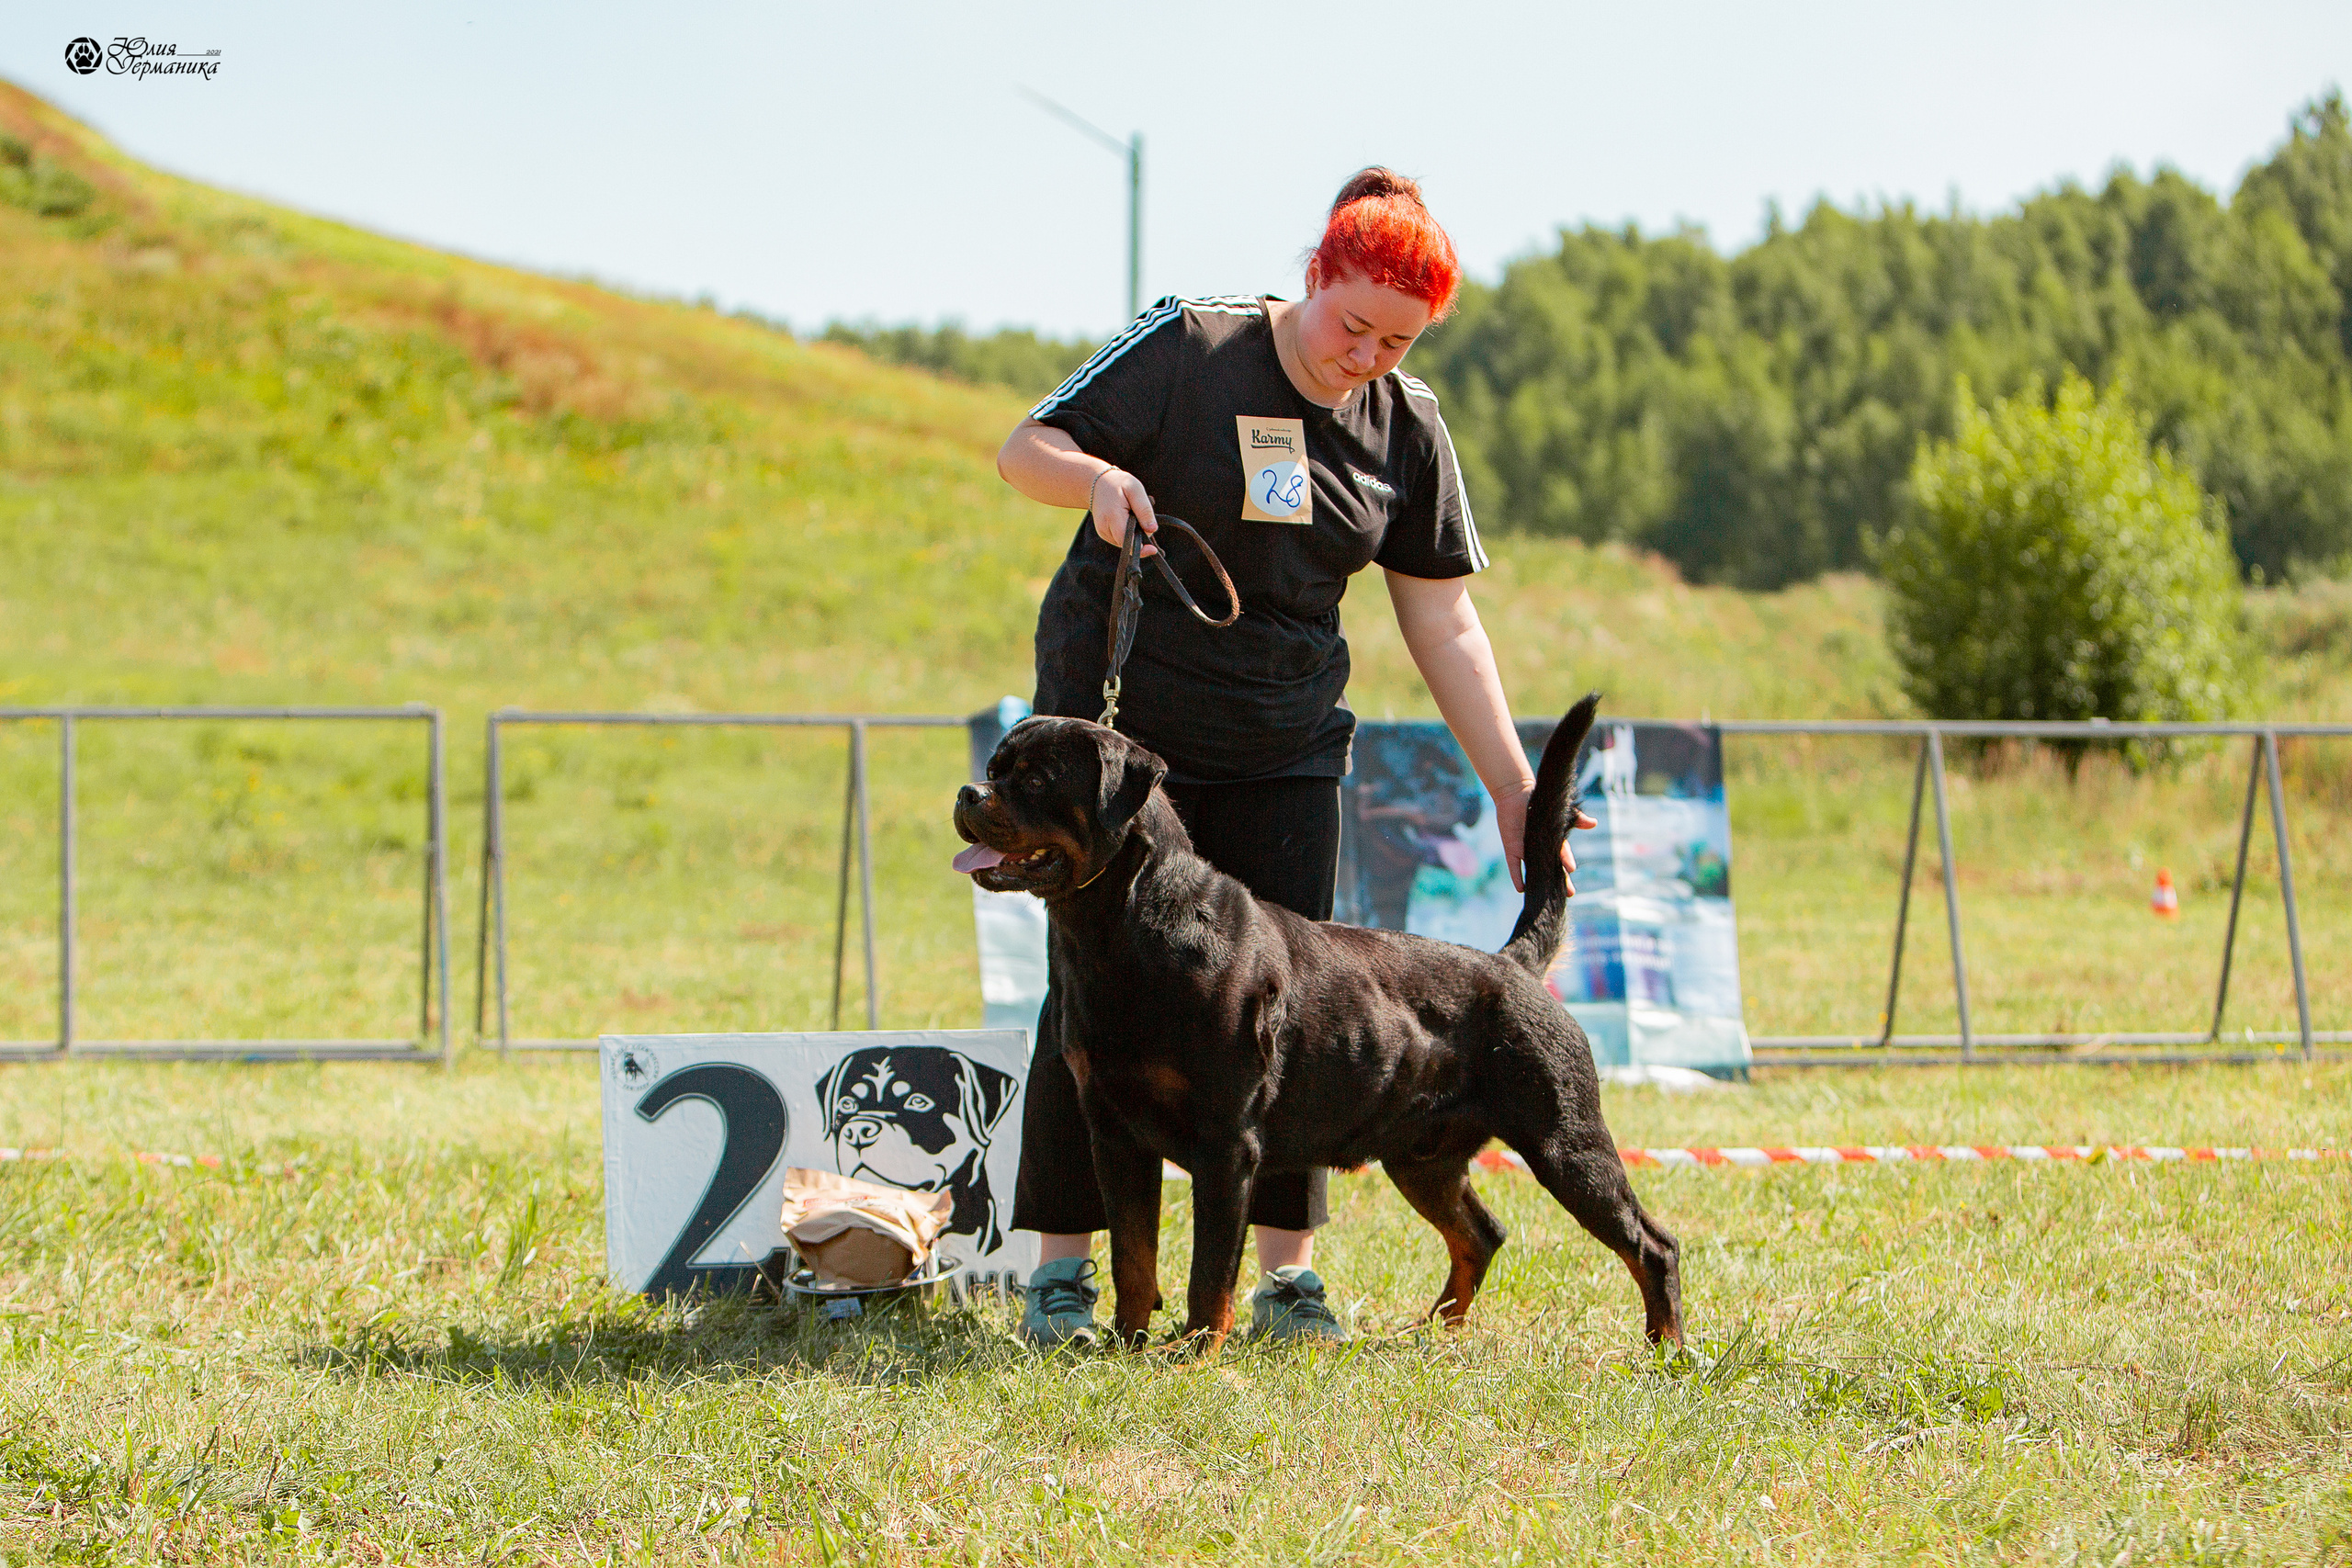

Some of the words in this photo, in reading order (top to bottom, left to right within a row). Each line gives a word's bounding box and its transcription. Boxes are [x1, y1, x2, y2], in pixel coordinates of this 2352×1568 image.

[1250, 428, 1295, 454] Karmy
[1261, 468, 1304, 508] 28
[1352, 470, 1393, 493] adidas
[634, 1061, 790, 1309] 2
